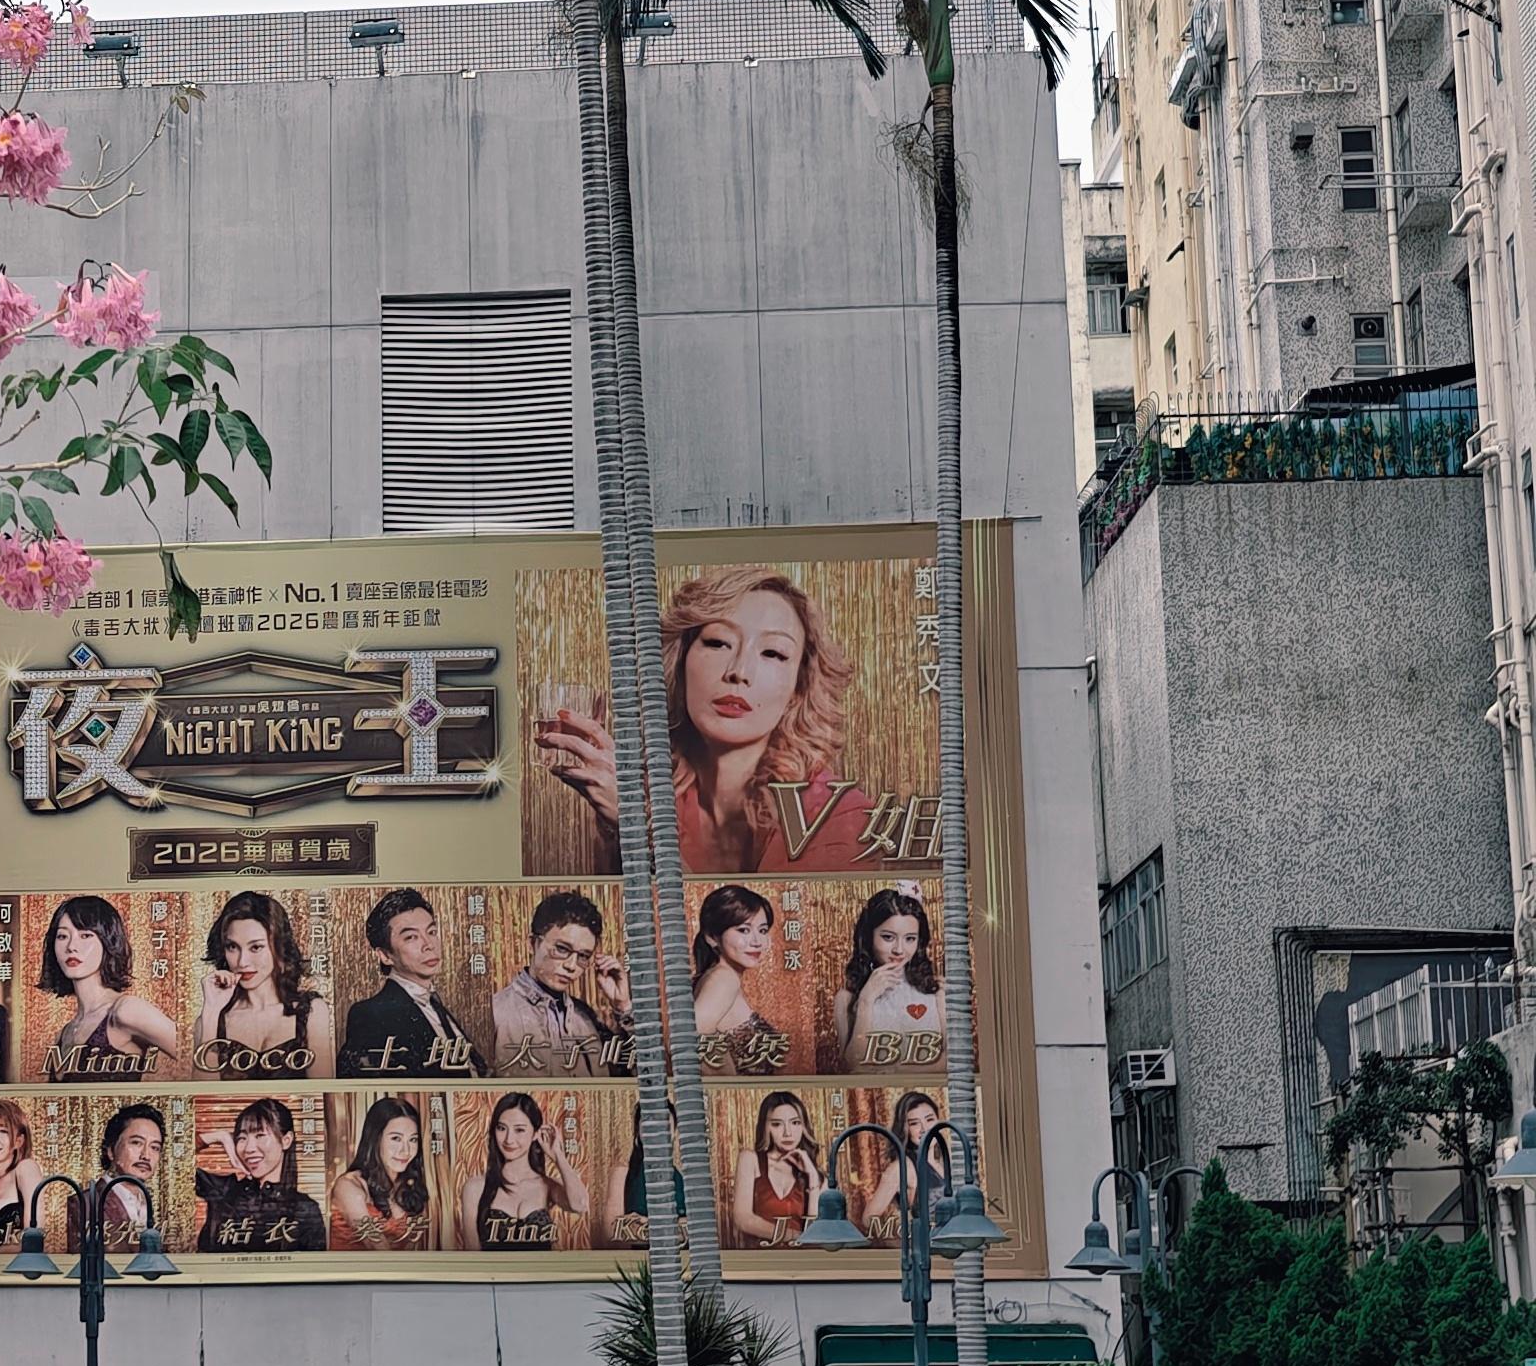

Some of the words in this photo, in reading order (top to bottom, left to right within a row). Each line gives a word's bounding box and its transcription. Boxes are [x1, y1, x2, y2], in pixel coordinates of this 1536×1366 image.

[152, 837, 352, 867] 2026華麗賀歲
[309, 896, 328, 976] 王丹妮
[40, 1042, 163, 1076] Mimi
[192, 1037, 315, 1074] Coco
[360, 1034, 472, 1073] 土地
[863, 1031, 944, 1066] BB
[484, 1216, 559, 1244] Tina
